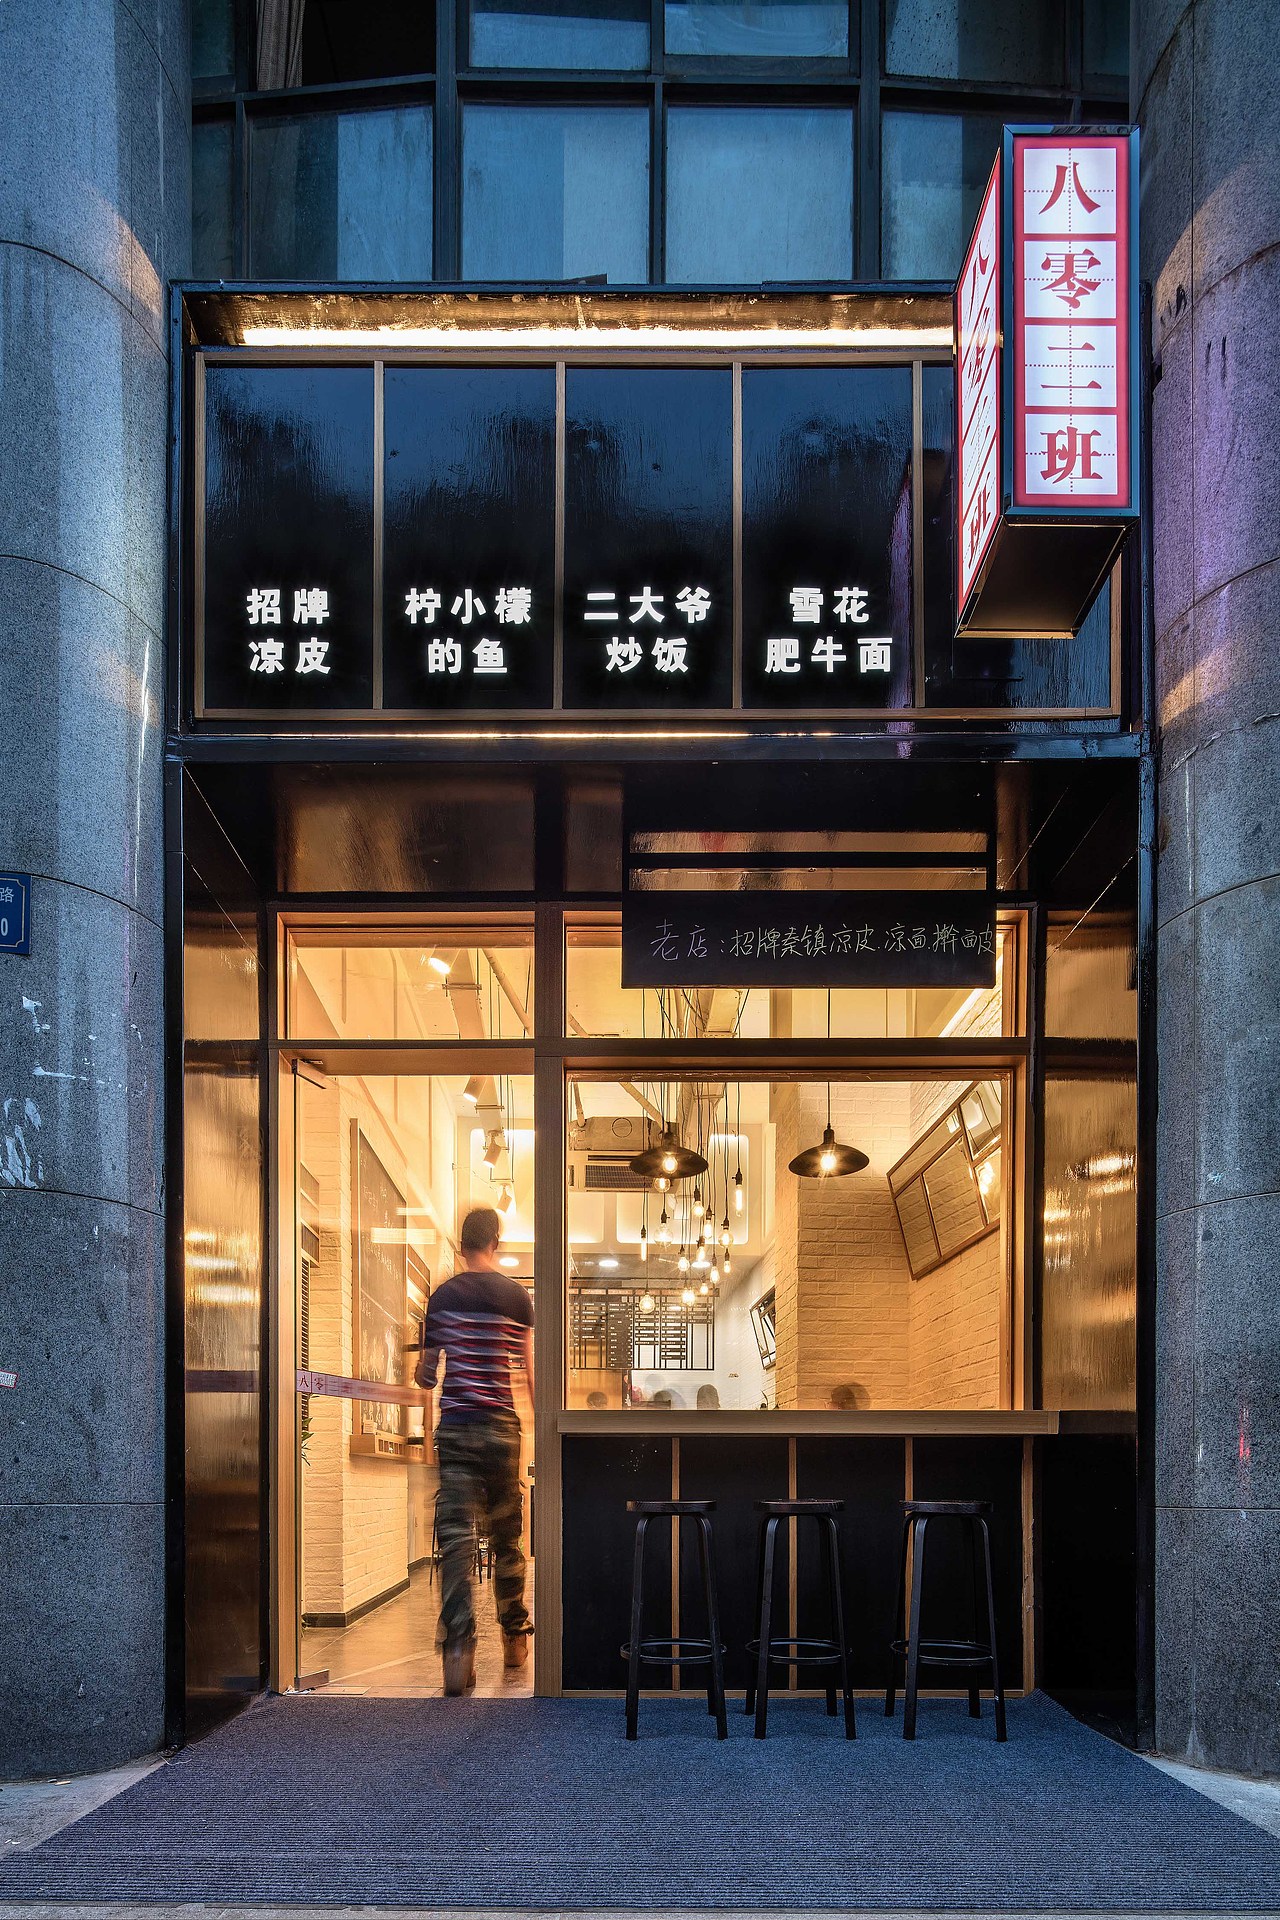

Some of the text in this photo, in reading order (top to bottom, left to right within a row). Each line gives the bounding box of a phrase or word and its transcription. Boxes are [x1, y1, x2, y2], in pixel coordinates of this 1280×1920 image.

[1038, 161, 1104, 485] 八零二班
[247, 587, 330, 624] 招牌
[404, 586, 532, 625] 柠小檬
[584, 586, 712, 624] 二大爷
[789, 586, 870, 624] 雪花
[248, 636, 331, 675] 凉皮
[428, 637, 508, 674] 的鱼
[605, 636, 689, 673] 炒饭
[765, 635, 893, 674] 肥牛面
